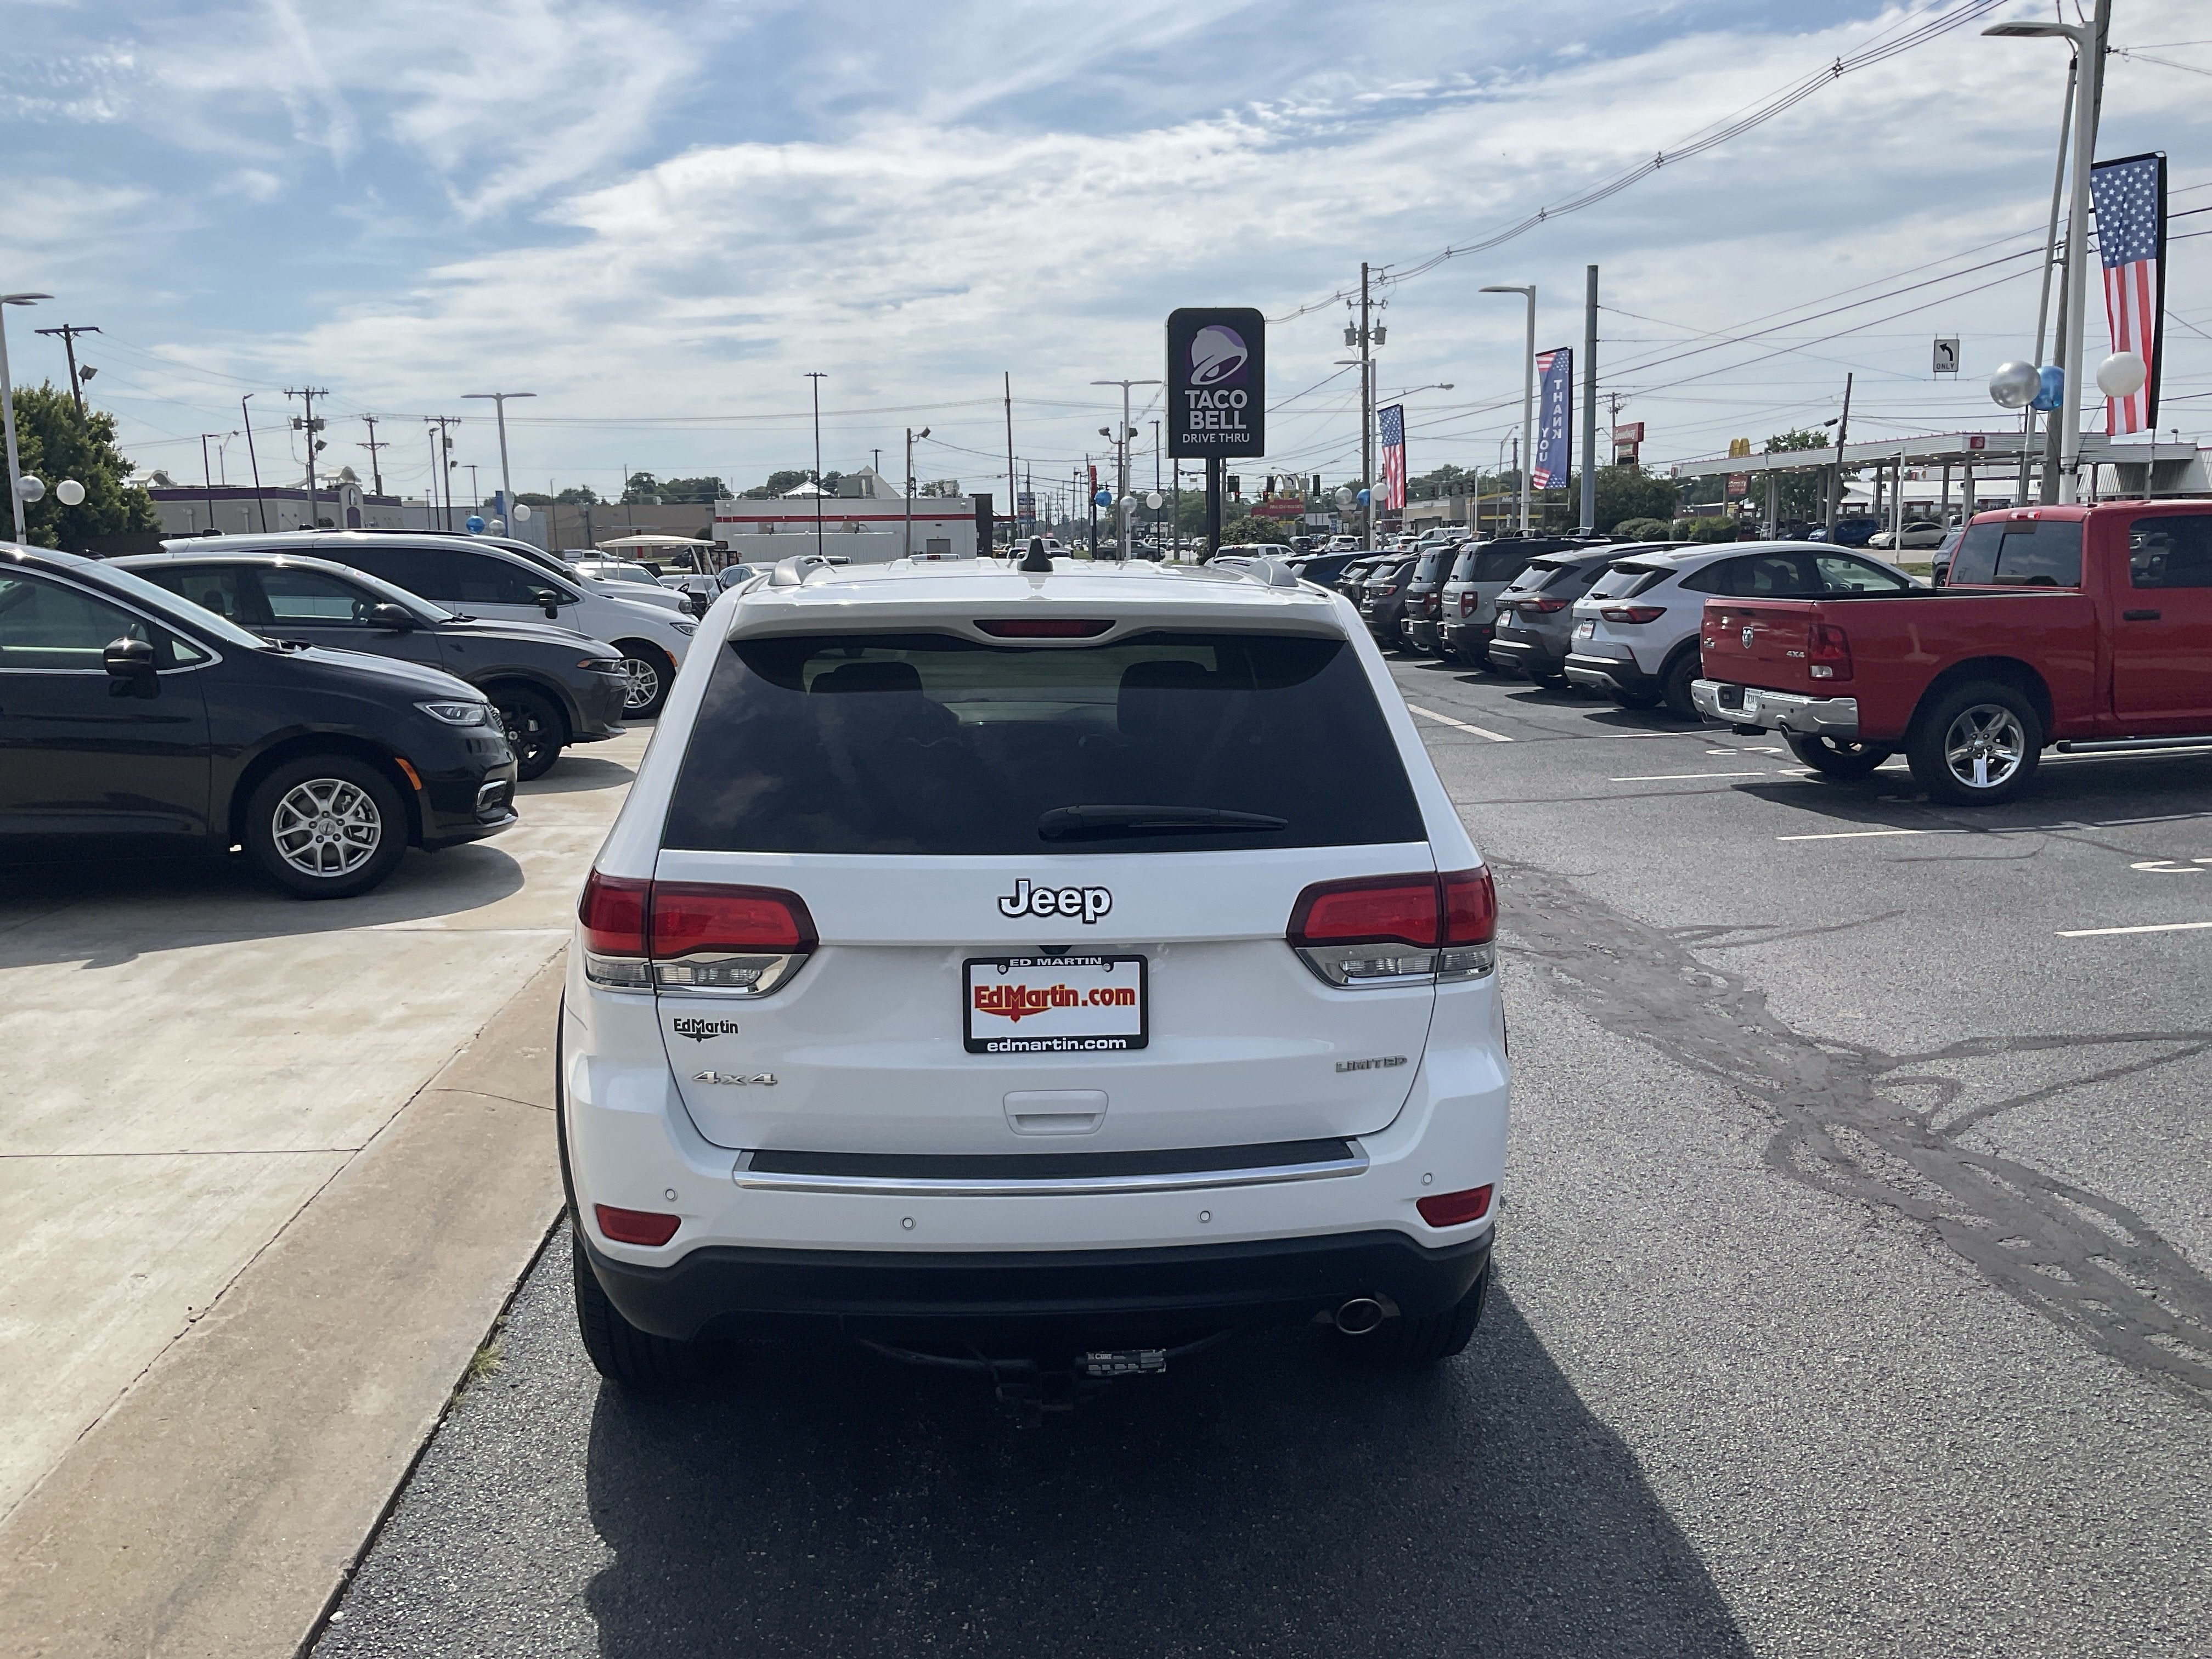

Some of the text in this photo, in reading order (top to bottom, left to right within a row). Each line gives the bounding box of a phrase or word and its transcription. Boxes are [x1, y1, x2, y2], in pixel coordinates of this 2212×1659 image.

[1184, 390, 1248, 409] TACO
[1190, 410, 1246, 430] BELL
[1182, 433, 1250, 443] DRIVE THRU
[998, 878, 1112, 924] Jeep
[1037, 957, 1102, 966] MARTIN
[974, 983, 1135, 1009] EdMartin.com
[674, 1018, 738, 1034] EdMartin
[987, 1037, 1127, 1052] edmartin.com
[1336, 1056, 1407, 1073] LIMITED
[692, 1070, 778, 1086] 4x4
